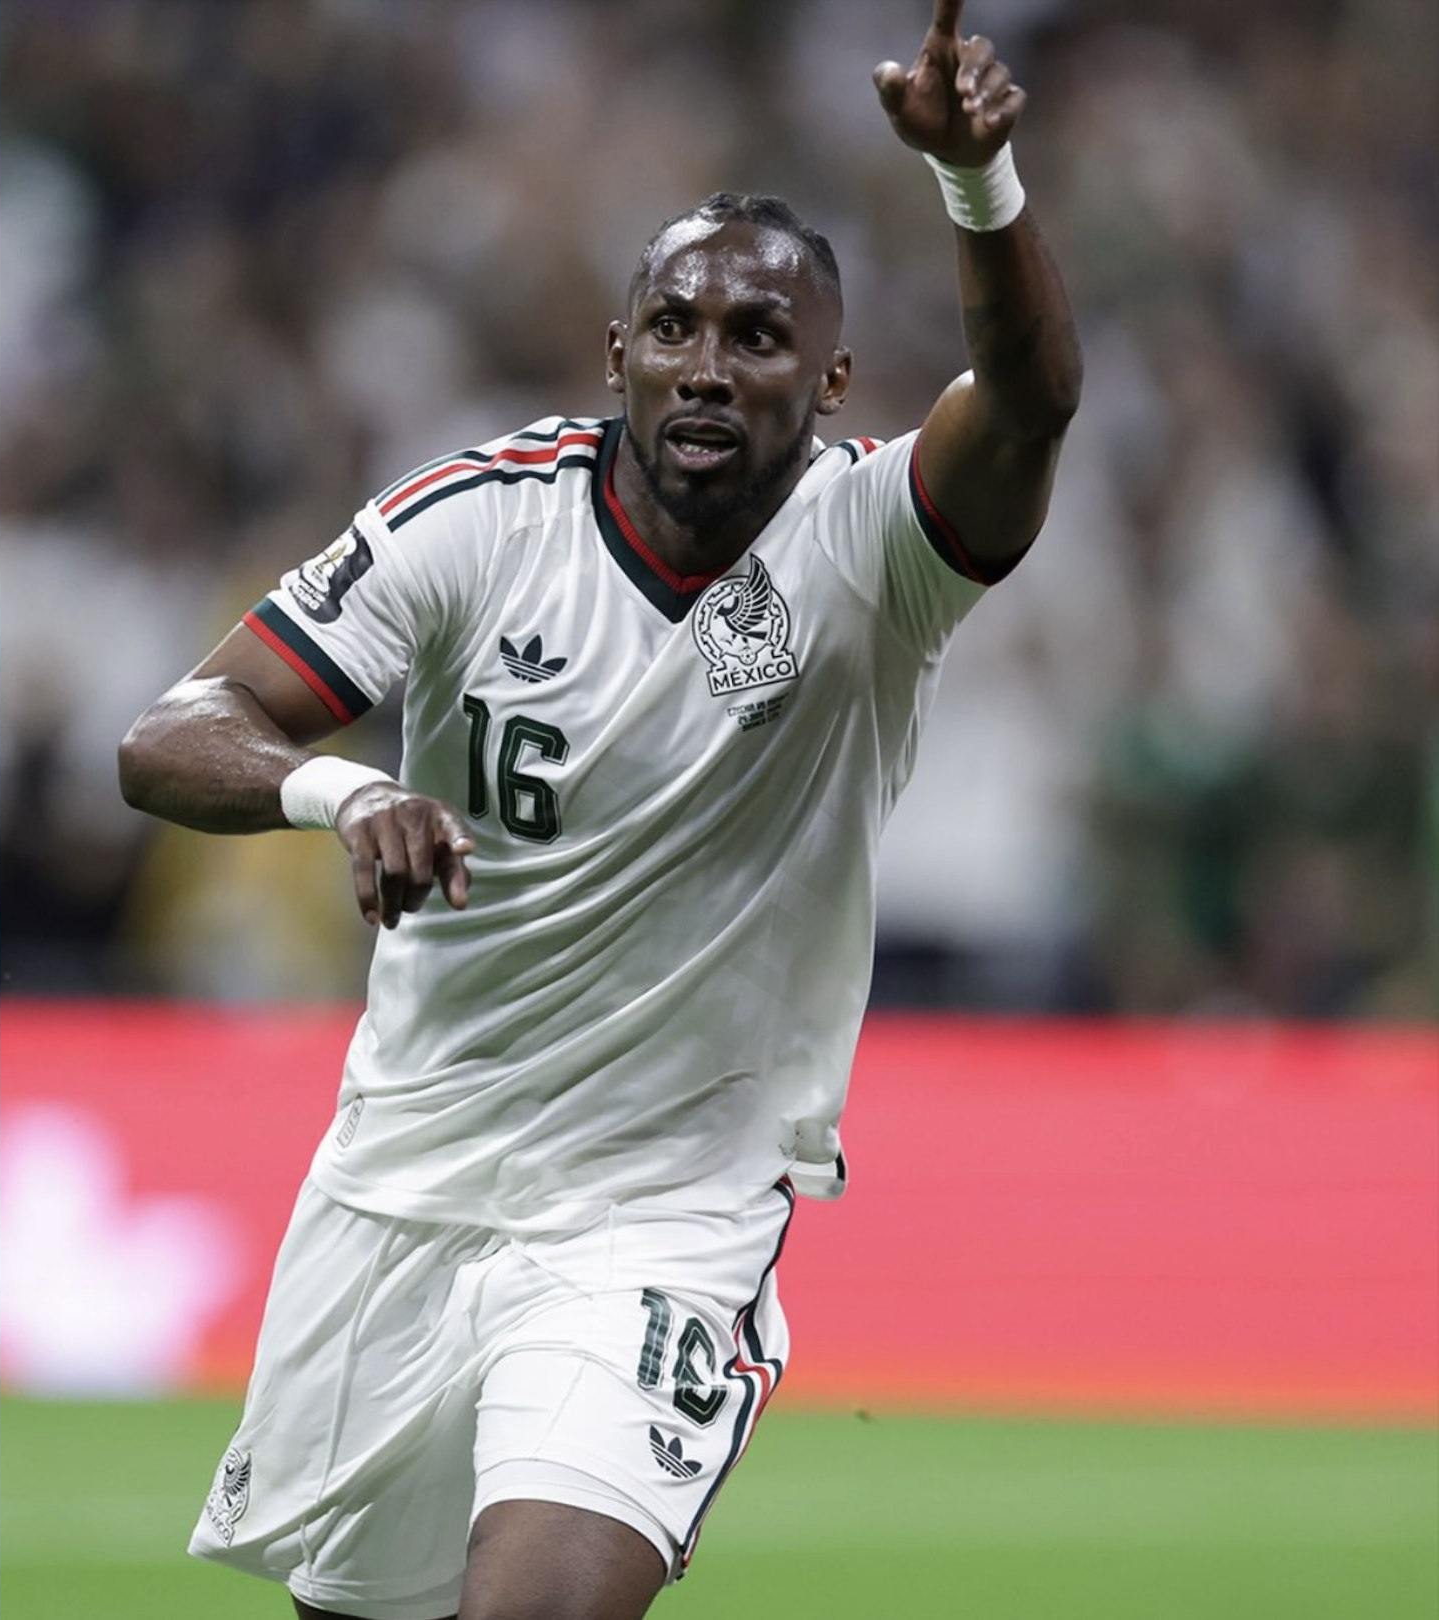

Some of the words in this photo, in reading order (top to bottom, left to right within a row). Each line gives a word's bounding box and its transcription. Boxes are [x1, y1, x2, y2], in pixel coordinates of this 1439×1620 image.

[712, 661, 792, 691] MÉXICO
[463, 692, 570, 845] 16
[637, 1288, 731, 1430] 16
